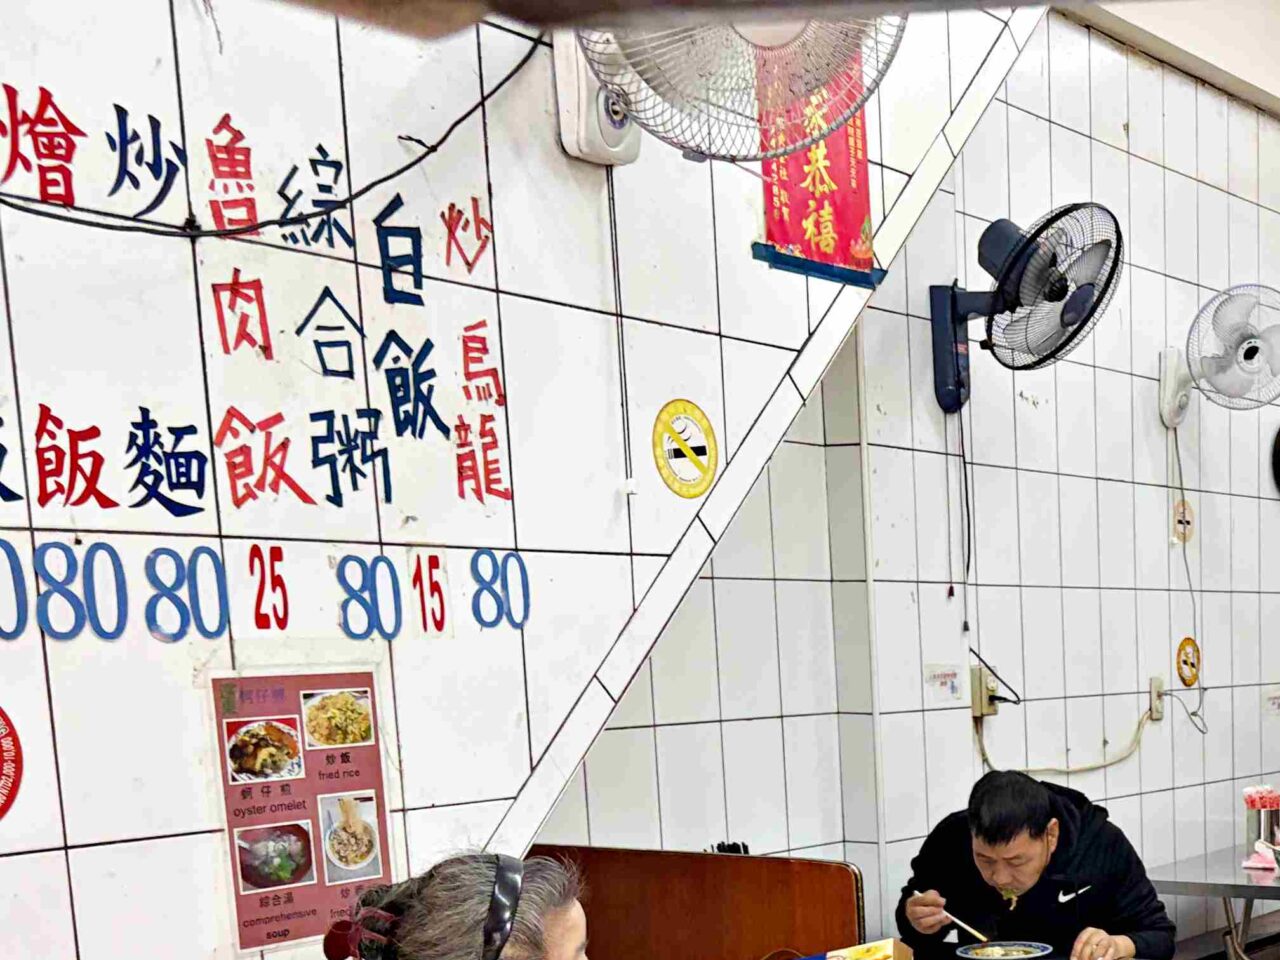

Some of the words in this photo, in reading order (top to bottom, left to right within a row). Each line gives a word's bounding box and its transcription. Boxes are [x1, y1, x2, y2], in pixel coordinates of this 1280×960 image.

[35, 541, 128, 641] 80
[145, 546, 229, 643] 80
[249, 544, 289, 631] 25
[336, 554, 402, 641] 80
[412, 553, 445, 632] 15
[470, 548, 530, 630] 80
[318, 769, 340, 781] fried
[342, 768, 361, 778] rice
[233, 804, 267, 819] oyster
[269, 799, 308, 813] omelet
[242, 908, 318, 928] comprehensive
[266, 928, 291, 940] soup
